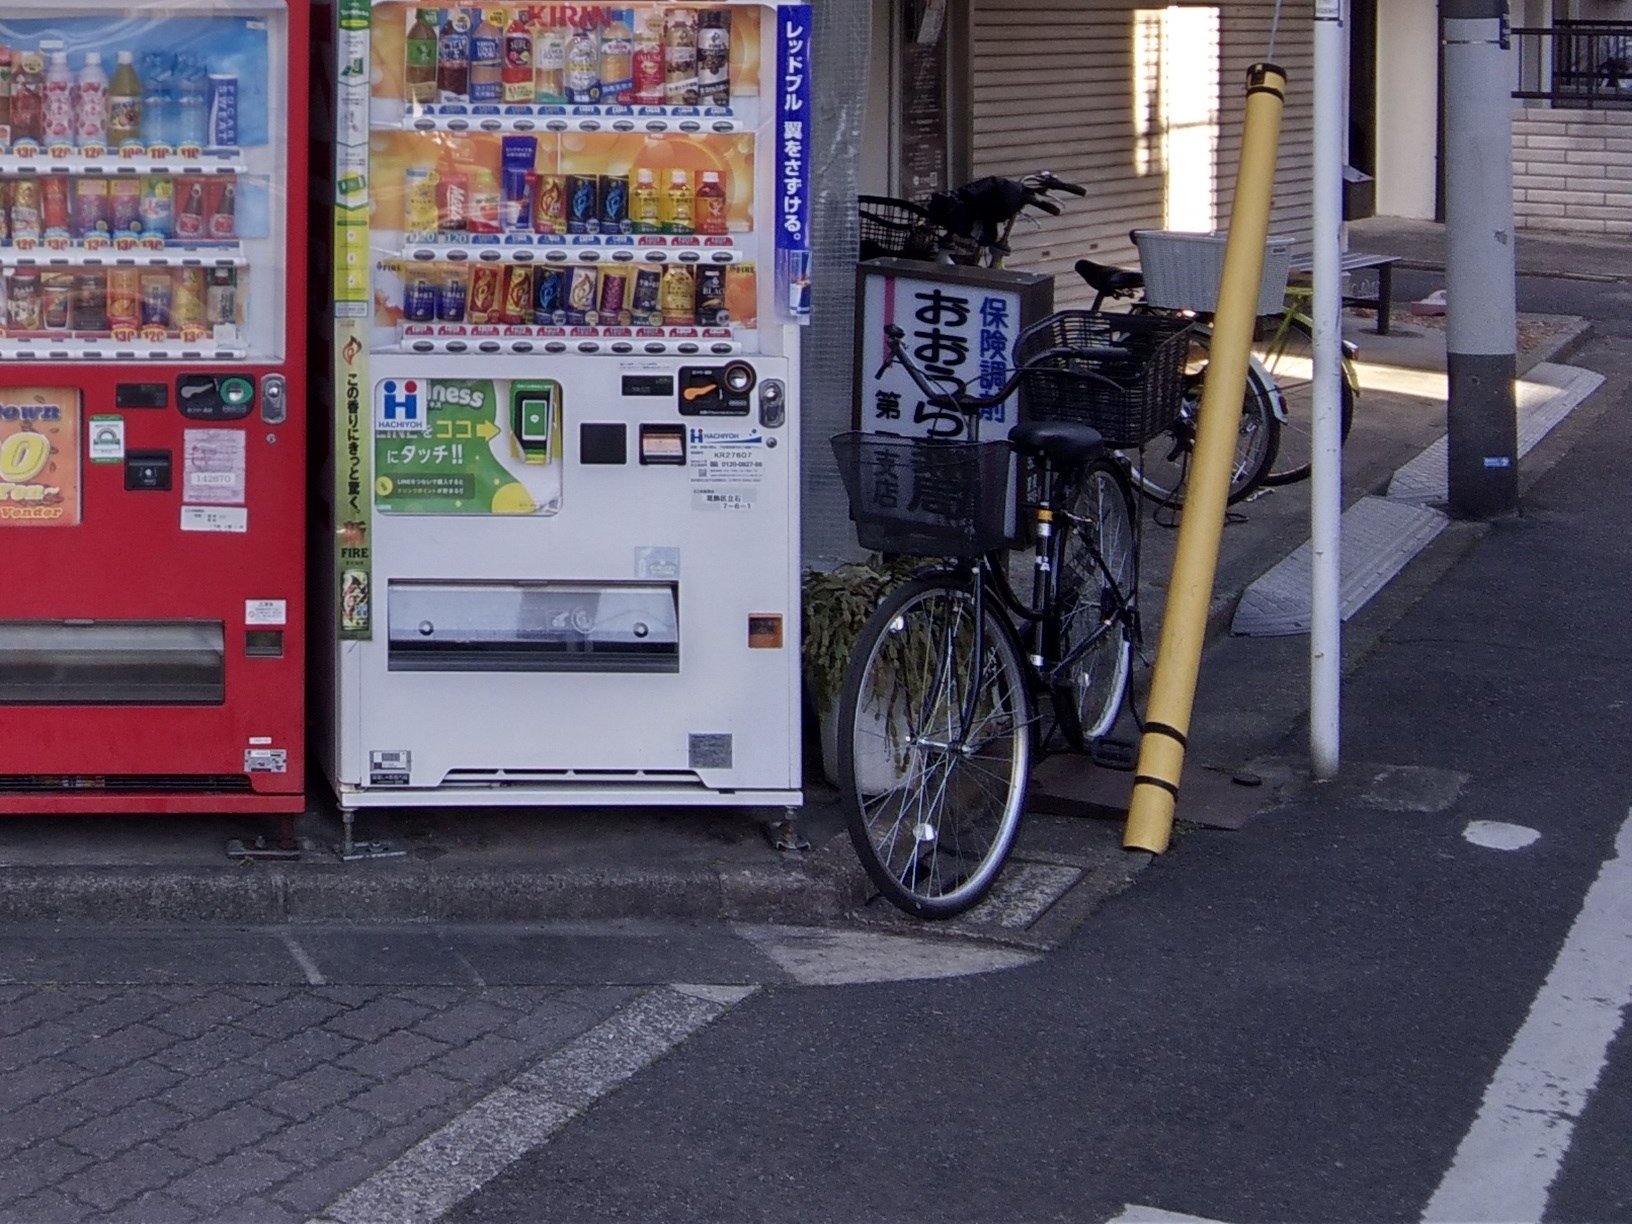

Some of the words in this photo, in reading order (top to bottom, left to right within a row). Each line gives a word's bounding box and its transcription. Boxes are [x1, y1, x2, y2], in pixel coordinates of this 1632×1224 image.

[528, 5, 612, 28] KIRIN
[783, 20, 803, 112] レッドブル
[218, 85, 228, 141] SWEAT
[226, 85, 235, 146] POCARI
[783, 121, 803, 241] 翼をさずける。
[378, 421, 423, 429] HACHIYOH
[341, 547, 369, 558] FIRE
